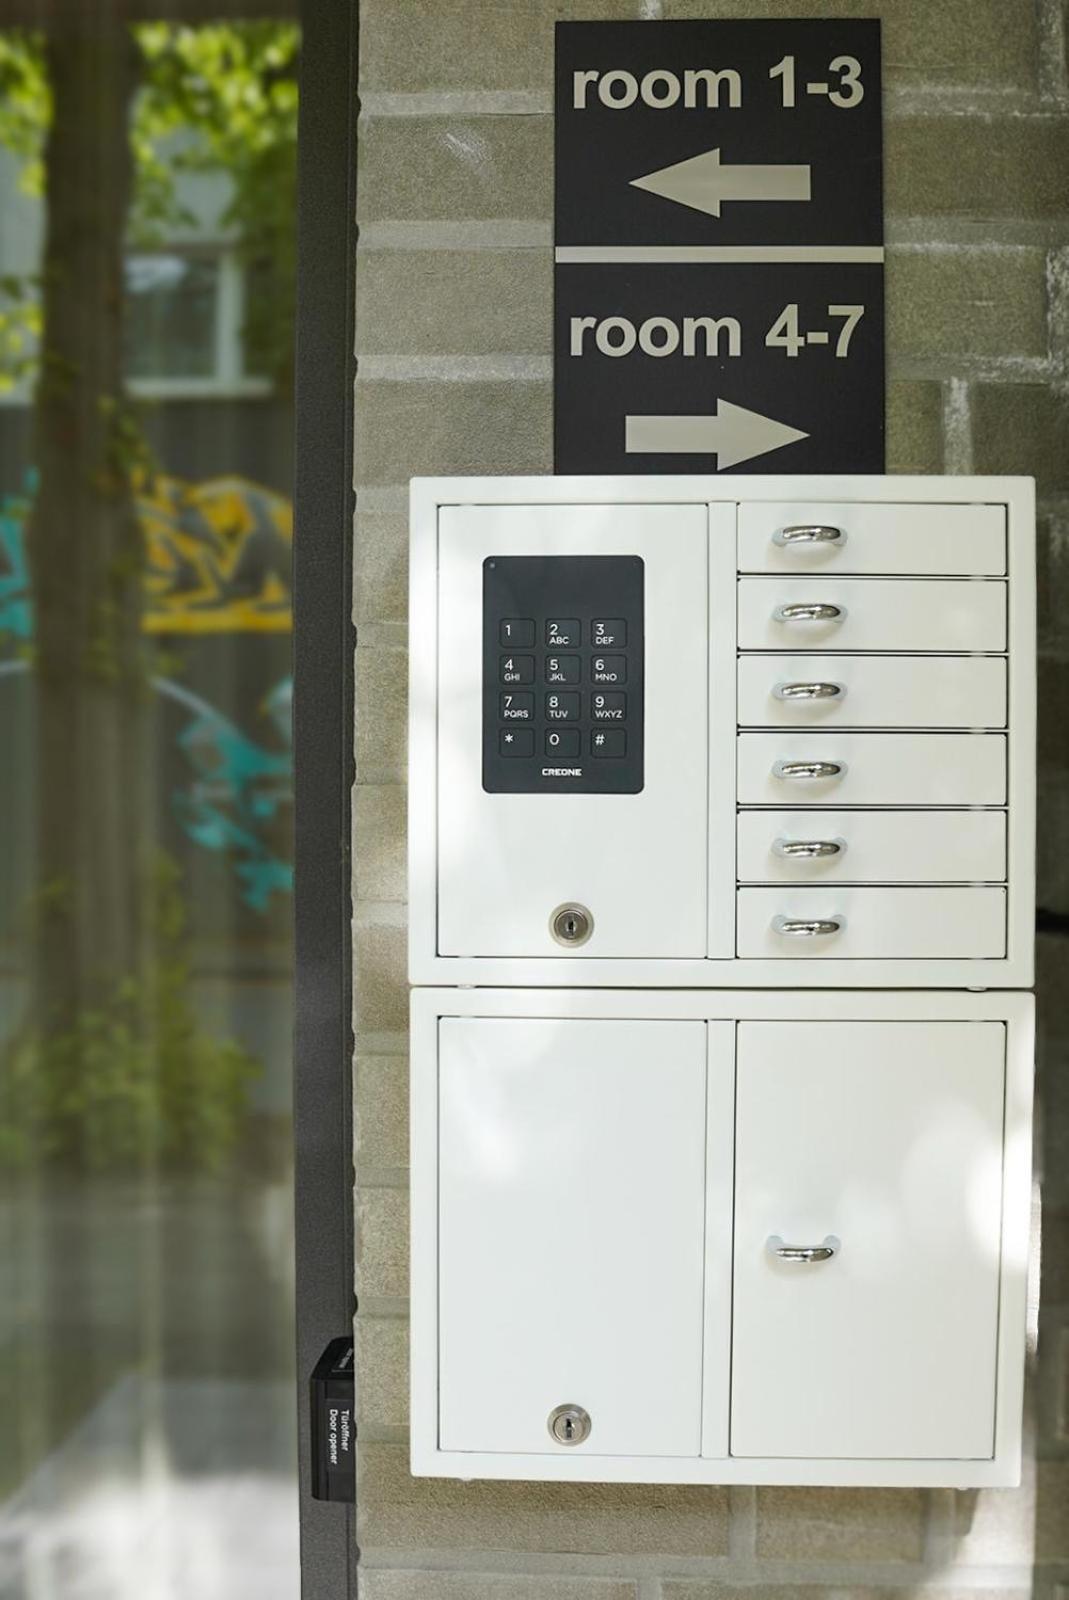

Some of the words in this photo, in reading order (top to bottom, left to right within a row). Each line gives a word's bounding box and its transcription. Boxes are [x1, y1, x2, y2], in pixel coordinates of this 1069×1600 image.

[573, 67, 742, 110] room
[768, 55, 864, 109] 1-3
[570, 315, 742, 357] room
[765, 303, 865, 358] 4-7
[505, 624, 512, 636] 1
[550, 623, 559, 636] 2
[595, 623, 605, 636] 3
[549, 636, 570, 645] ABC
[595, 636, 615, 645] DEF
[504, 658, 514, 671] 4
[550, 658, 559, 671] 5
[595, 658, 605, 671] 6
[503, 673, 521, 682] GHI
[549, 673, 566, 682] JKL
[595, 673, 617, 682] MNO
[503, 695, 513, 708] 7
[549, 695, 559, 708] 8
[595, 695, 605, 708] 9
[503, 709, 529, 719] PQRS
[549, 709, 569, 719] TUV
[595, 709, 623, 719] WXYZ
[594, 733, 606, 746] #
[541, 767, 583, 777] CREONE
[329, 1408, 339, 1432] Door
[340, 1409, 350, 1452] Türöffner
[328, 1432, 338, 1465] opener
